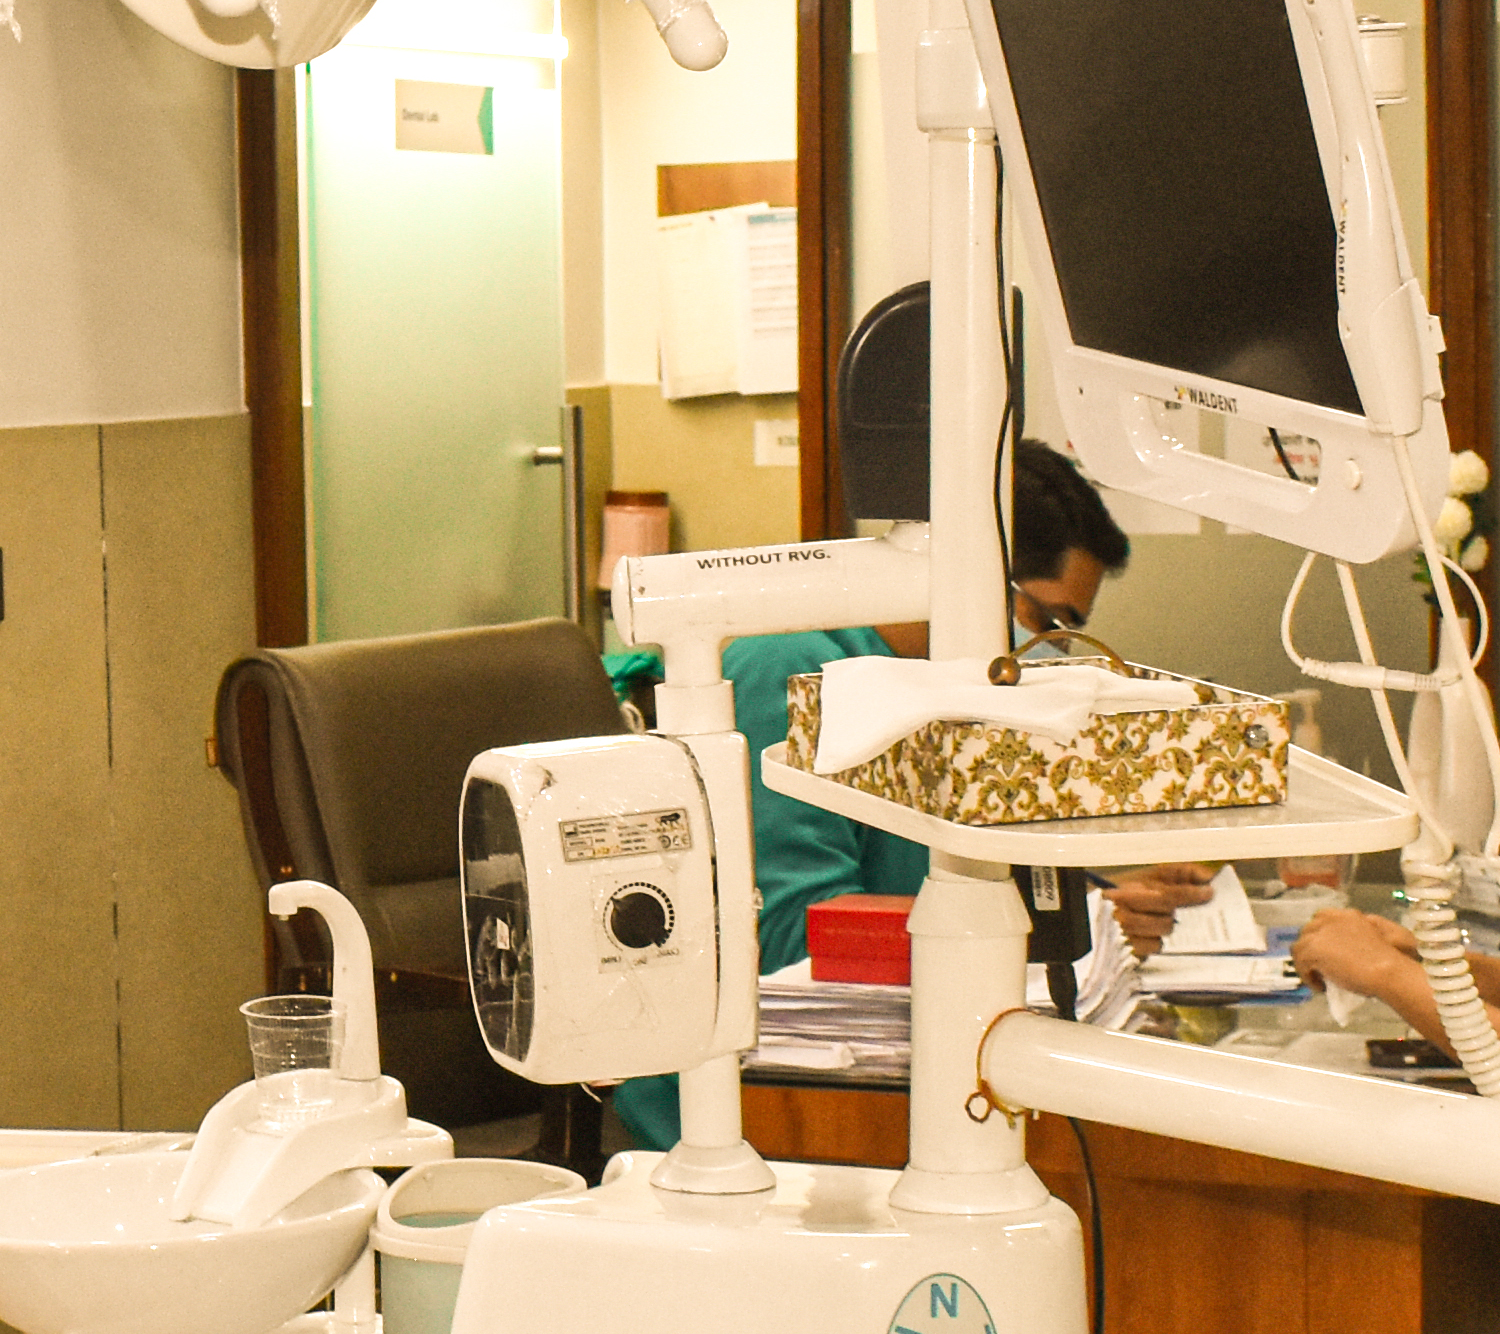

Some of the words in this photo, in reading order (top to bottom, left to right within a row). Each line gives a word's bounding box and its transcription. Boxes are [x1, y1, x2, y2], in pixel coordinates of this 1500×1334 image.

[1338, 220, 1347, 295] WALDENT
[1187, 387, 1238, 414] WALDENT
[696, 551, 783, 570] WITHOUT
[788, 548, 831, 562] RVG.
